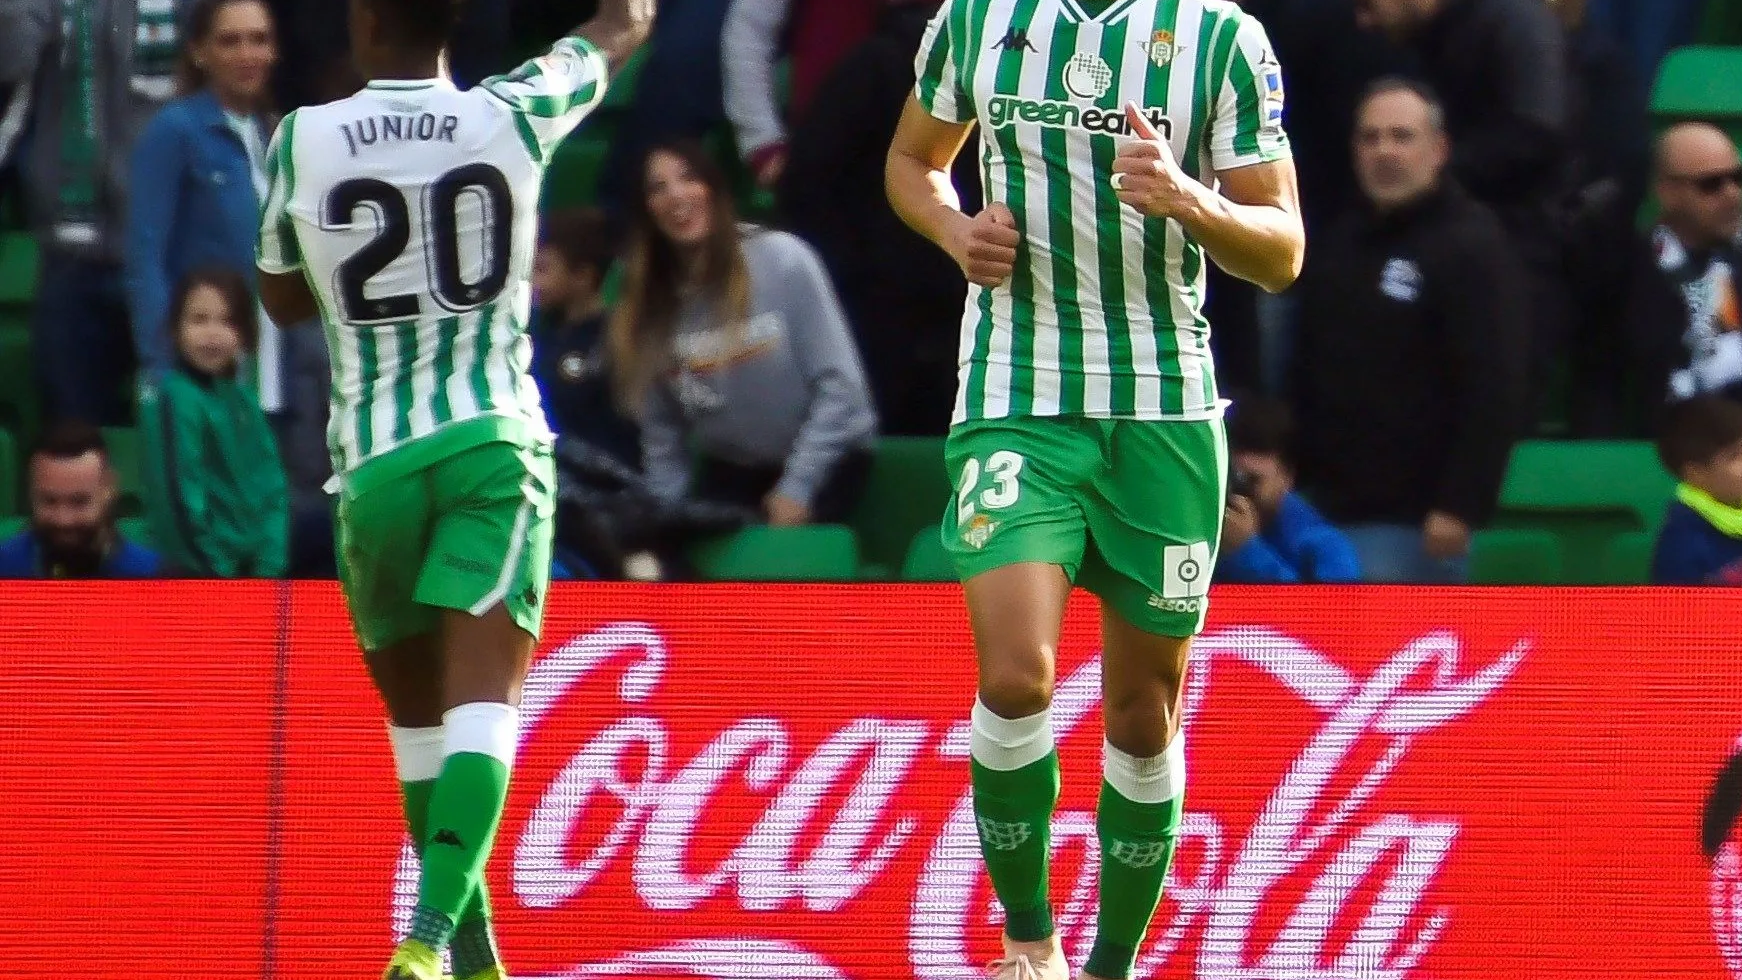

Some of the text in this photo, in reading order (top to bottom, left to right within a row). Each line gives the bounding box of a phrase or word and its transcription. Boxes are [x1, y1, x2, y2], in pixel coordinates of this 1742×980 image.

[340, 113, 458, 157] JUNIOR
[988, 97, 1080, 127] green
[318, 162, 513, 327] 20
[958, 450, 1024, 527] 23
